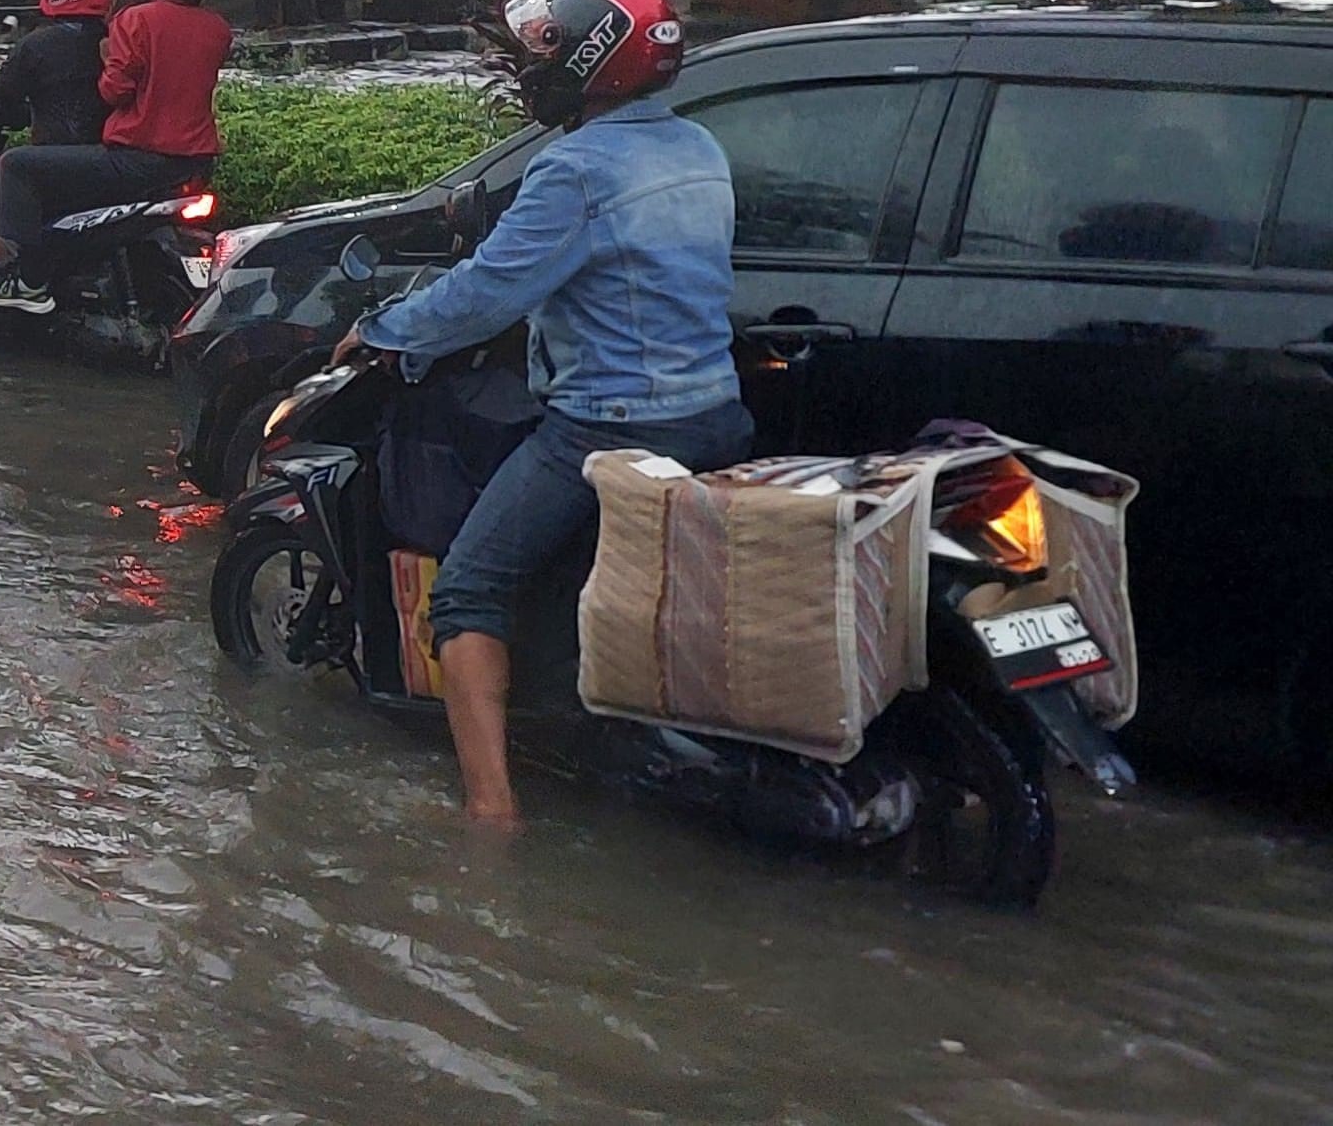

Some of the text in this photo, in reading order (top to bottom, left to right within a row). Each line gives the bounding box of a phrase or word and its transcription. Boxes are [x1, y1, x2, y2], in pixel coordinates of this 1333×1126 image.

[565, 11, 616, 77] KYT
[307, 466, 337, 493] FI
[983, 627, 1003, 654] E
[1008, 616, 1055, 648] 3174
